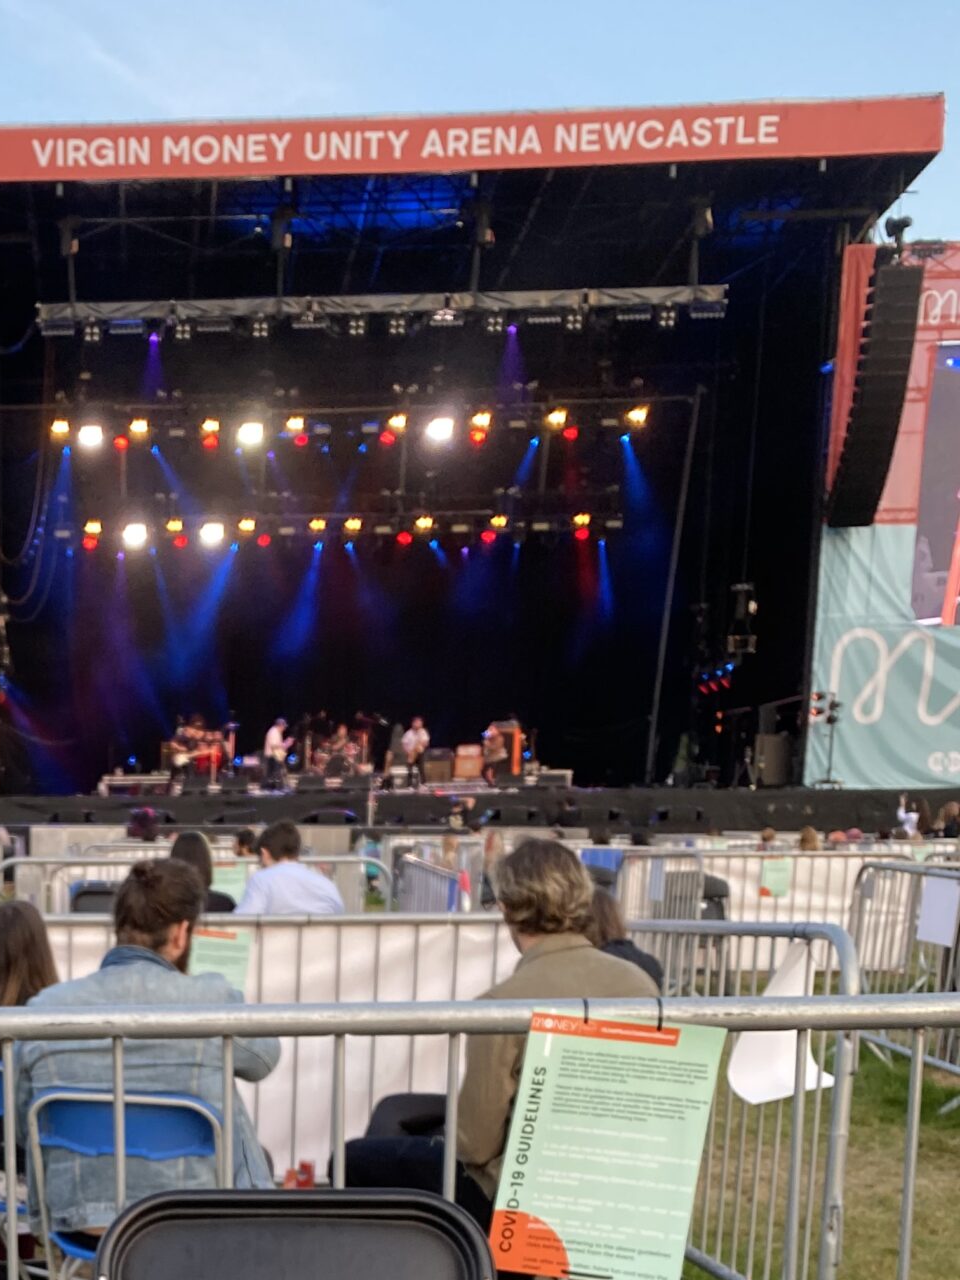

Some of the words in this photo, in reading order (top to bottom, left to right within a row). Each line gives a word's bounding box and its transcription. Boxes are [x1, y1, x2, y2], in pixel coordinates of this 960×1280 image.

[31, 137, 151, 168] VIRGIN
[162, 133, 292, 165] MONEY
[304, 129, 410, 161] UNITY
[420, 125, 543, 159] ARENA
[554, 114, 780, 153] NEWCASTLE
[498, 1170, 526, 1253] COVID-19
[514, 1066, 548, 1166] GUIDELINES
